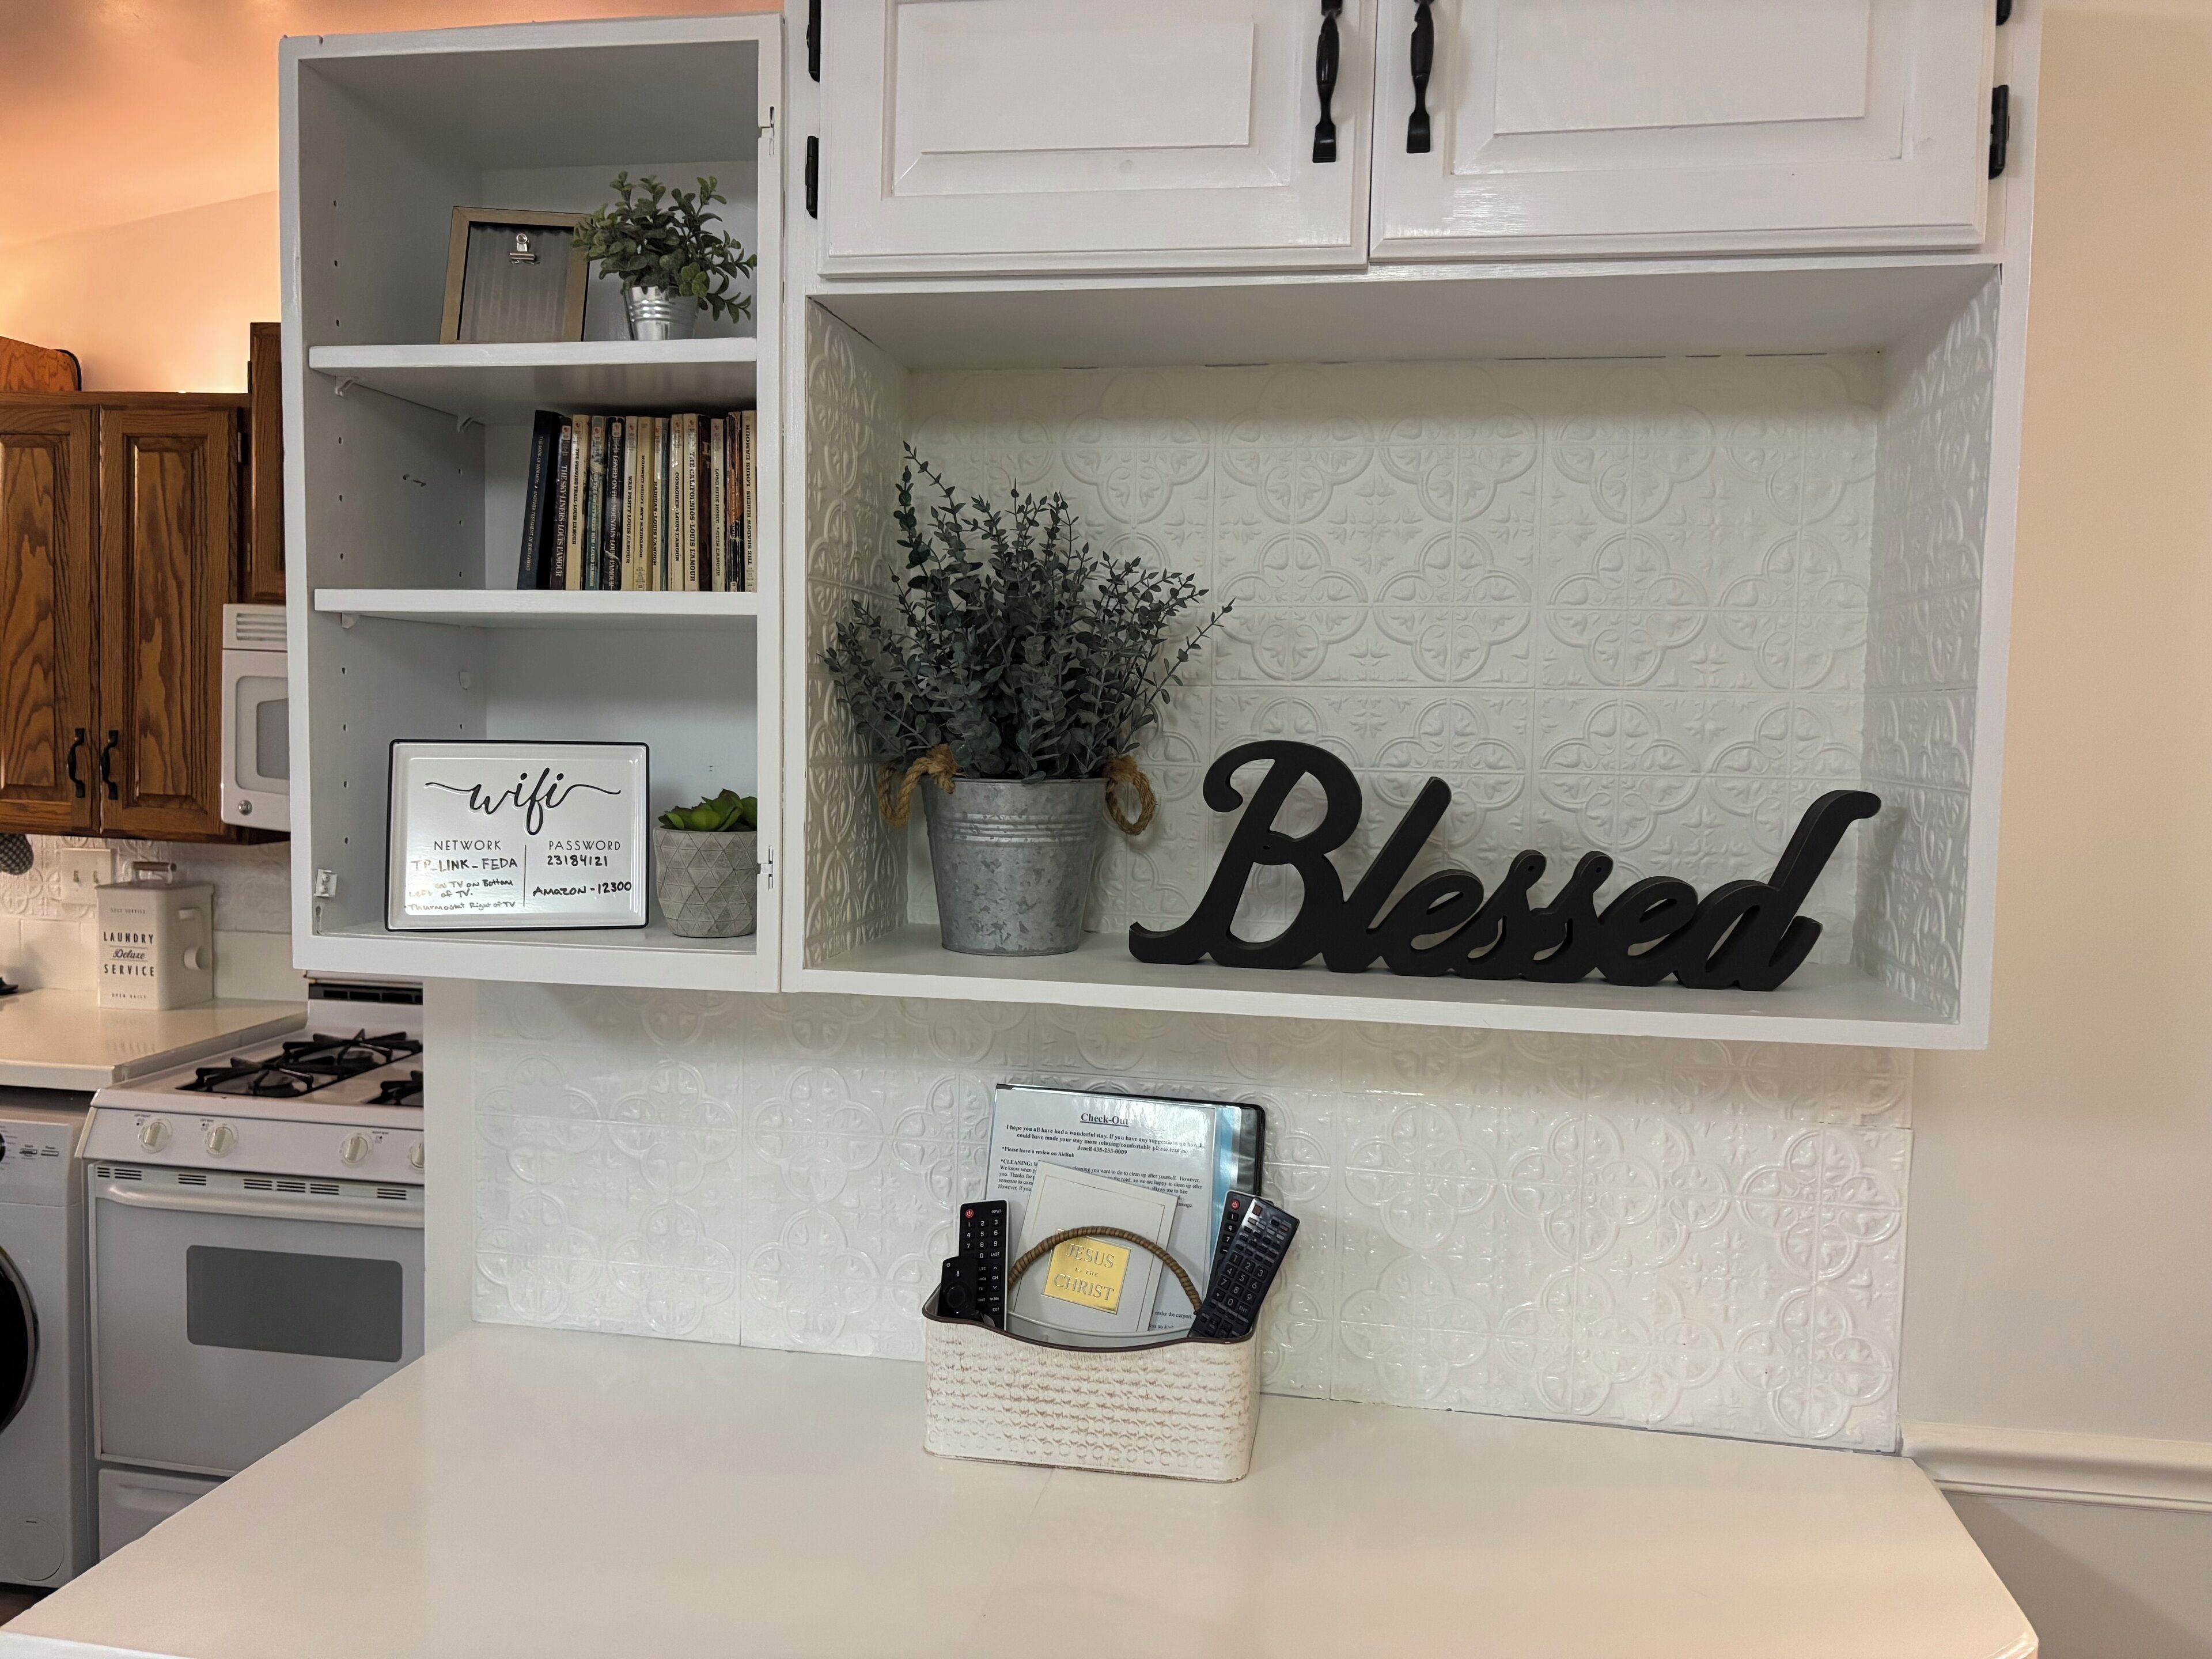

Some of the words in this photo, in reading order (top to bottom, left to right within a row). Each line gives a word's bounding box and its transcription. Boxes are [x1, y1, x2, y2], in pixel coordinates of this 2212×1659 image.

[612, 480, 618, 490] ON
[558, 480, 567, 522] SKY-LINERS
[555, 547, 563, 577] L'AMOUR
[425, 767, 621, 835] wifi
[434, 840, 502, 851] NETWORK
[549, 840, 620, 850] PASSWORD
[547, 855, 608, 866] 23184121
[1129, 739, 1882, 991] Blessed
[469, 902, 491, 911] Right
[104, 931, 153, 944] LAUNDRY
[113, 949, 145, 960] Deluxe
[104, 964, 154, 977] SERVICE
[1081, 1113, 1128, 1125] Check-Out
[1099, 1141, 1152, 1150] relaxing/comfortable
[1066, 1243, 1115, 1268] JESUS
[1086, 1269, 1099, 1277] THE
[1245, 1262, 1251, 1270] 2
[1257, 1269, 1264, 1277] 3
[1054, 1273, 1115, 1301] CHRIST
[1233, 1286, 1239, 1294] 8
[1228, 1298, 1233, 1306] 0
[1238, 1305, 1248, 1313] ENT
